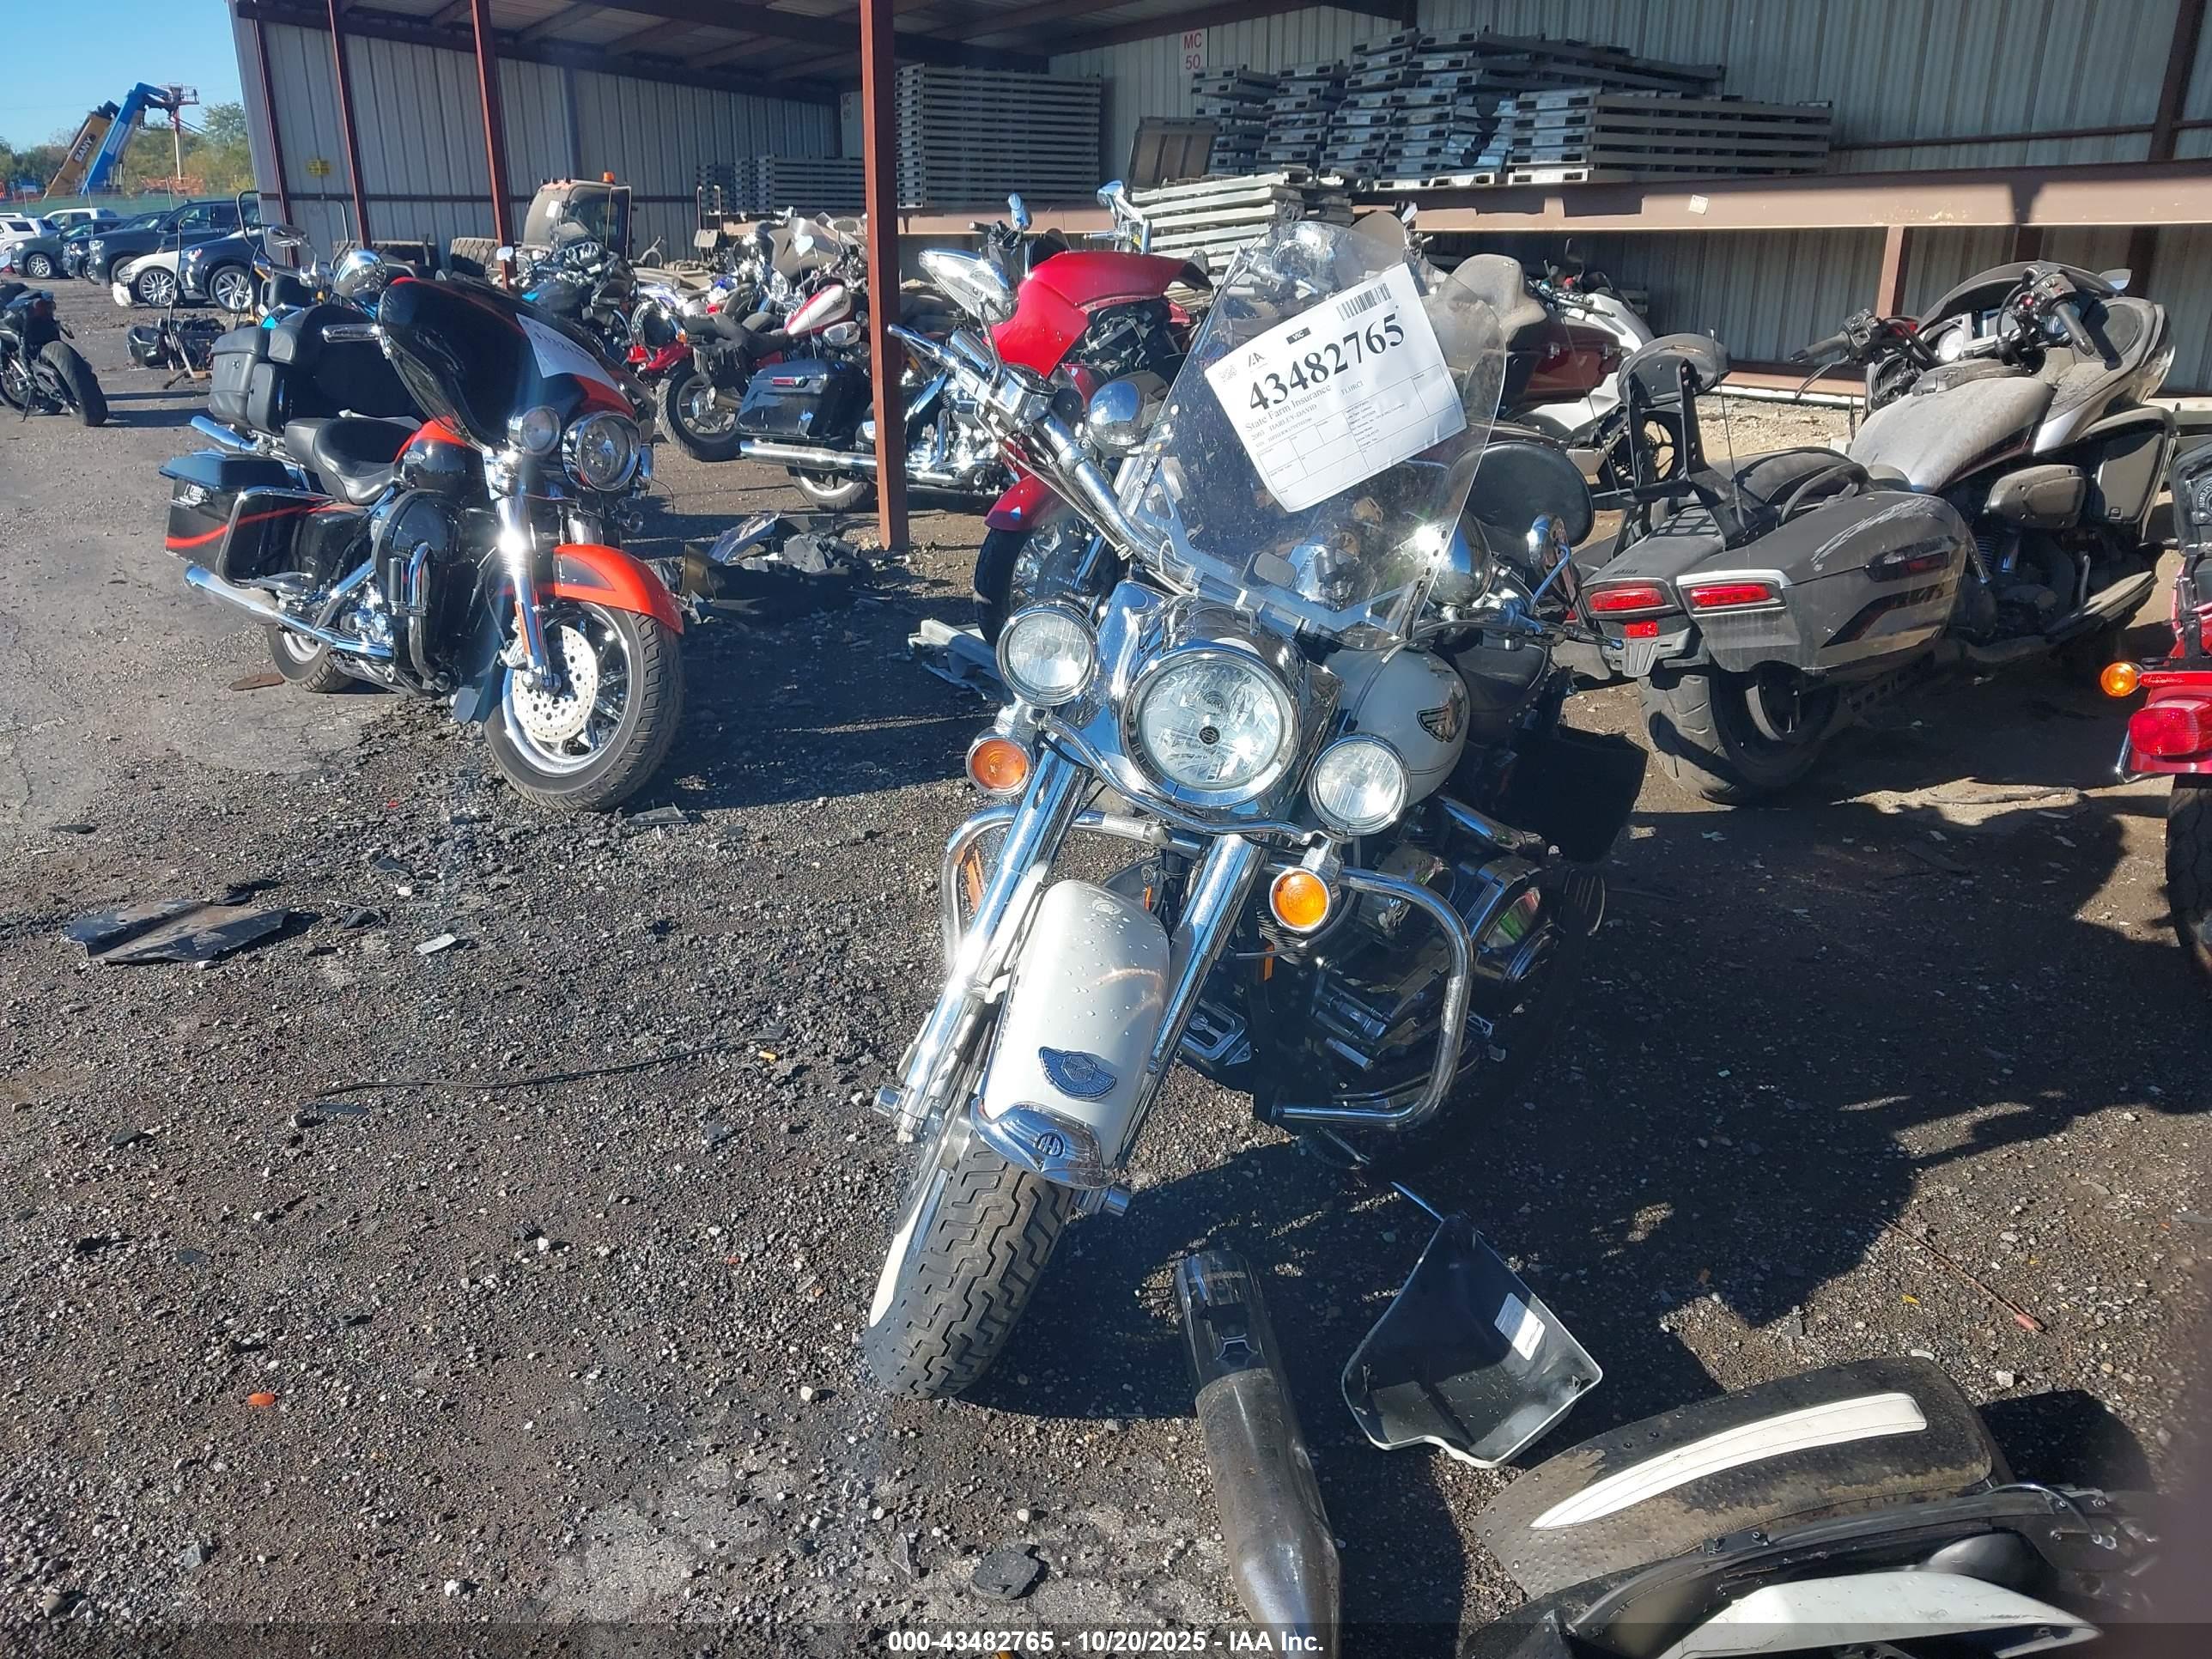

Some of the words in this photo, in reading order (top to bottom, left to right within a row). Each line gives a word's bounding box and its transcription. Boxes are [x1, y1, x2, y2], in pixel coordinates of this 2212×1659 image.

[1183, 33, 1202, 50] MC
[1185, 53, 1201, 70] 50
[1291, 330, 1305, 341] VIC
[1249, 312, 1405, 410] 43482765
[1244, 416, 1268, 432] State
[1267, 404, 1291, 421] Farm
[1291, 384, 1332, 409] Insurance
